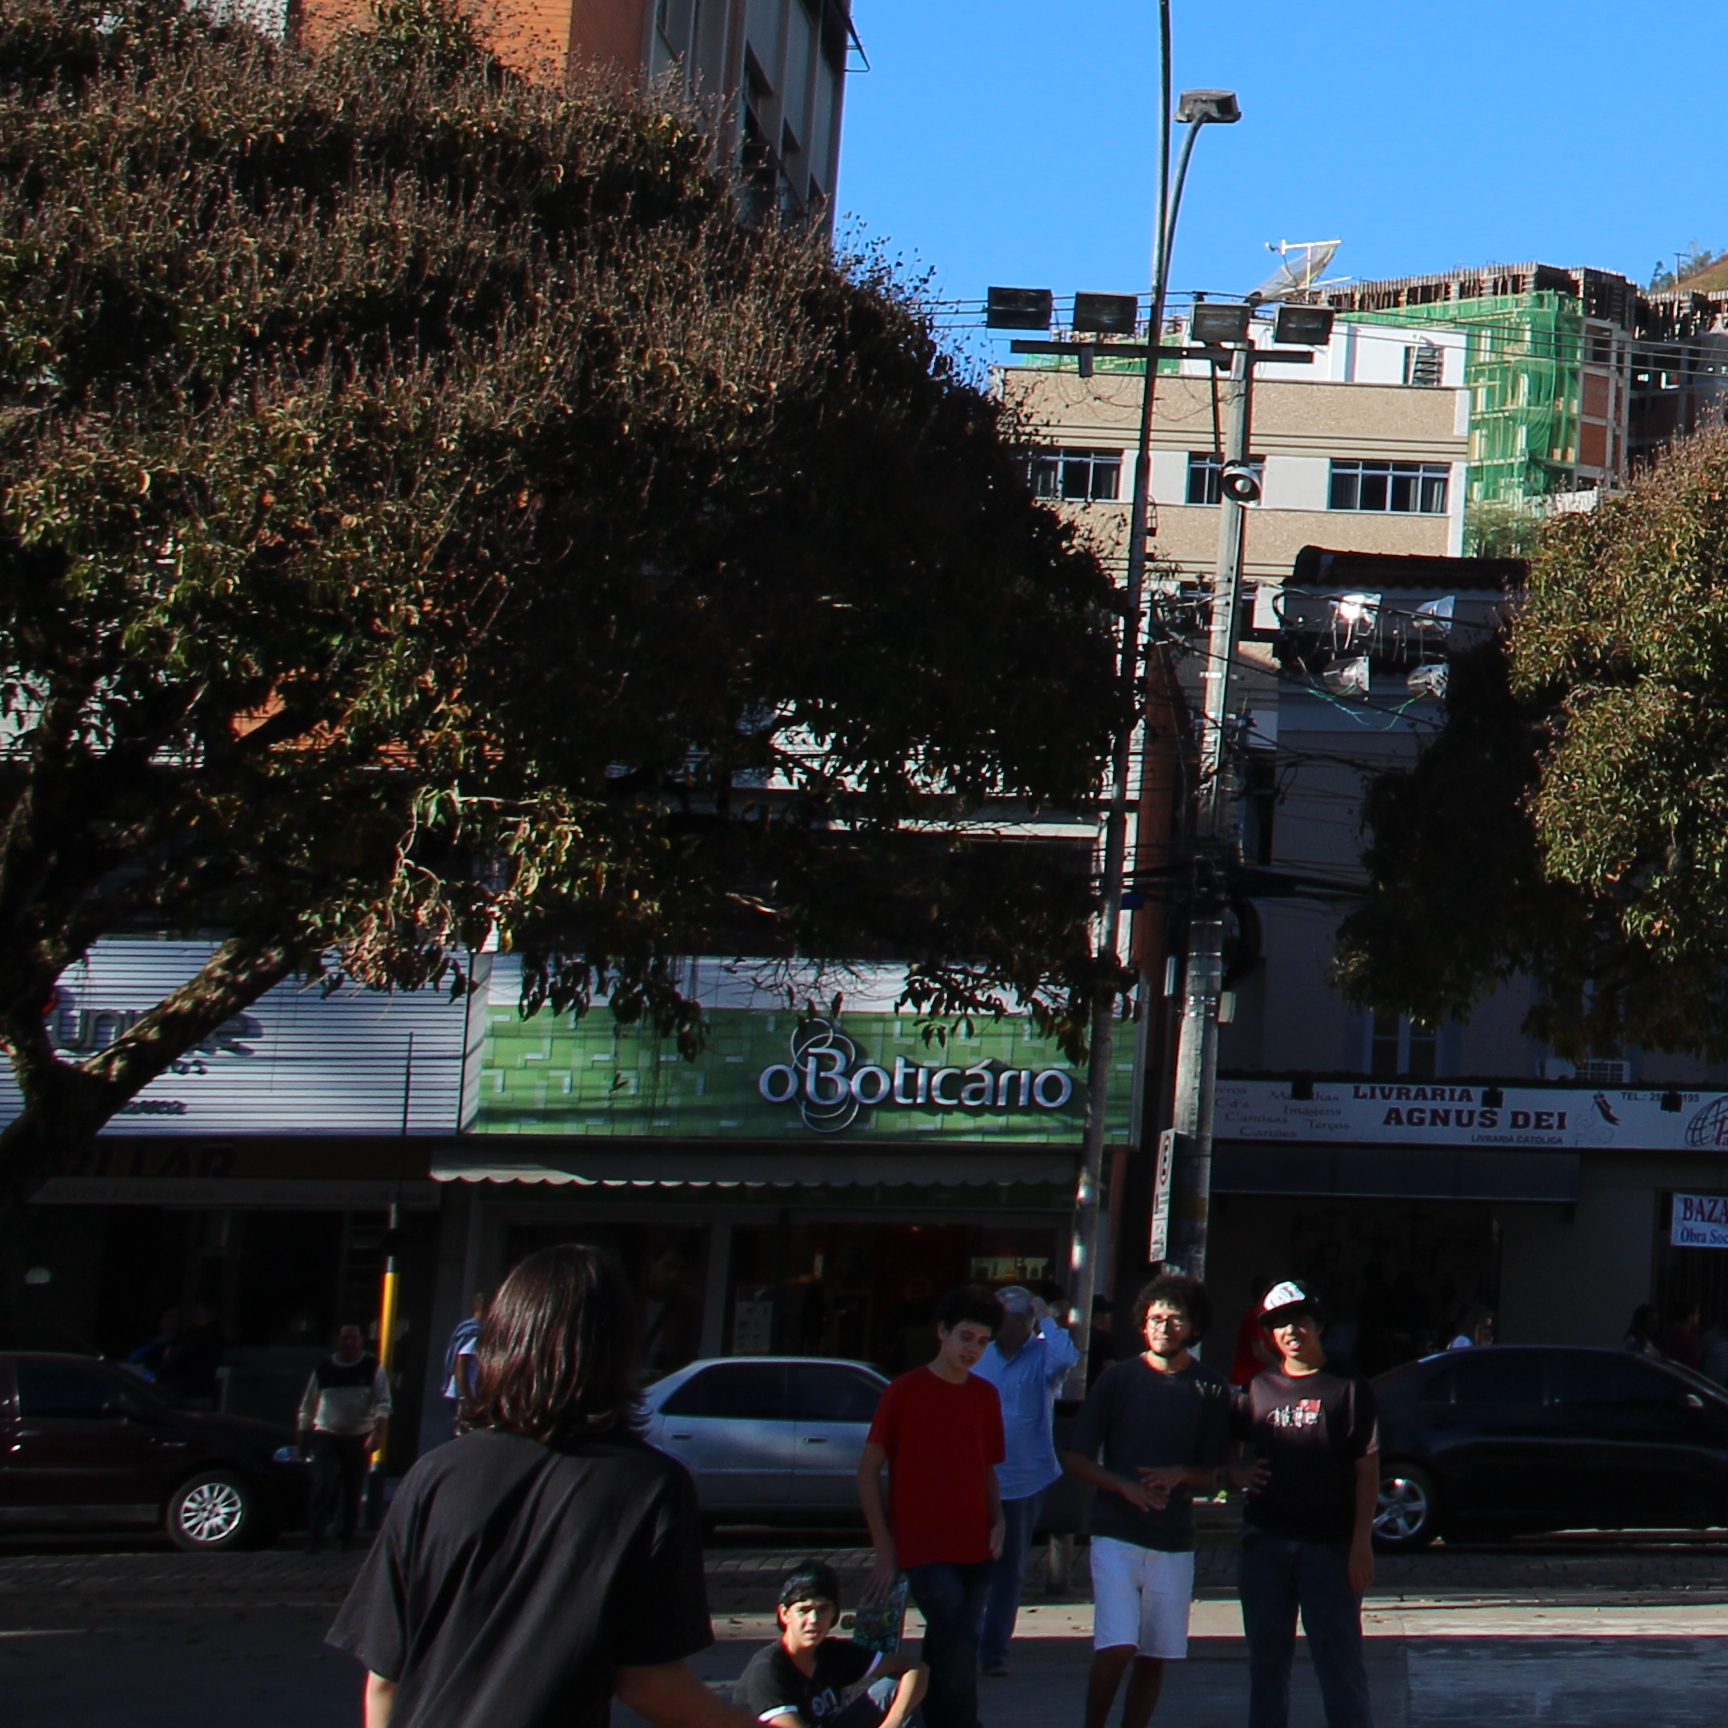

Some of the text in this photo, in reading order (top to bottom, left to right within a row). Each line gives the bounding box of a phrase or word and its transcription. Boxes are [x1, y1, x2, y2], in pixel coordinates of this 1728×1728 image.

[1353, 1085, 1474, 1103] LIVRARIA
[1383, 1107, 1567, 1130] AGNUS DEI
[1680, 1227, 1707, 1243] Obra
